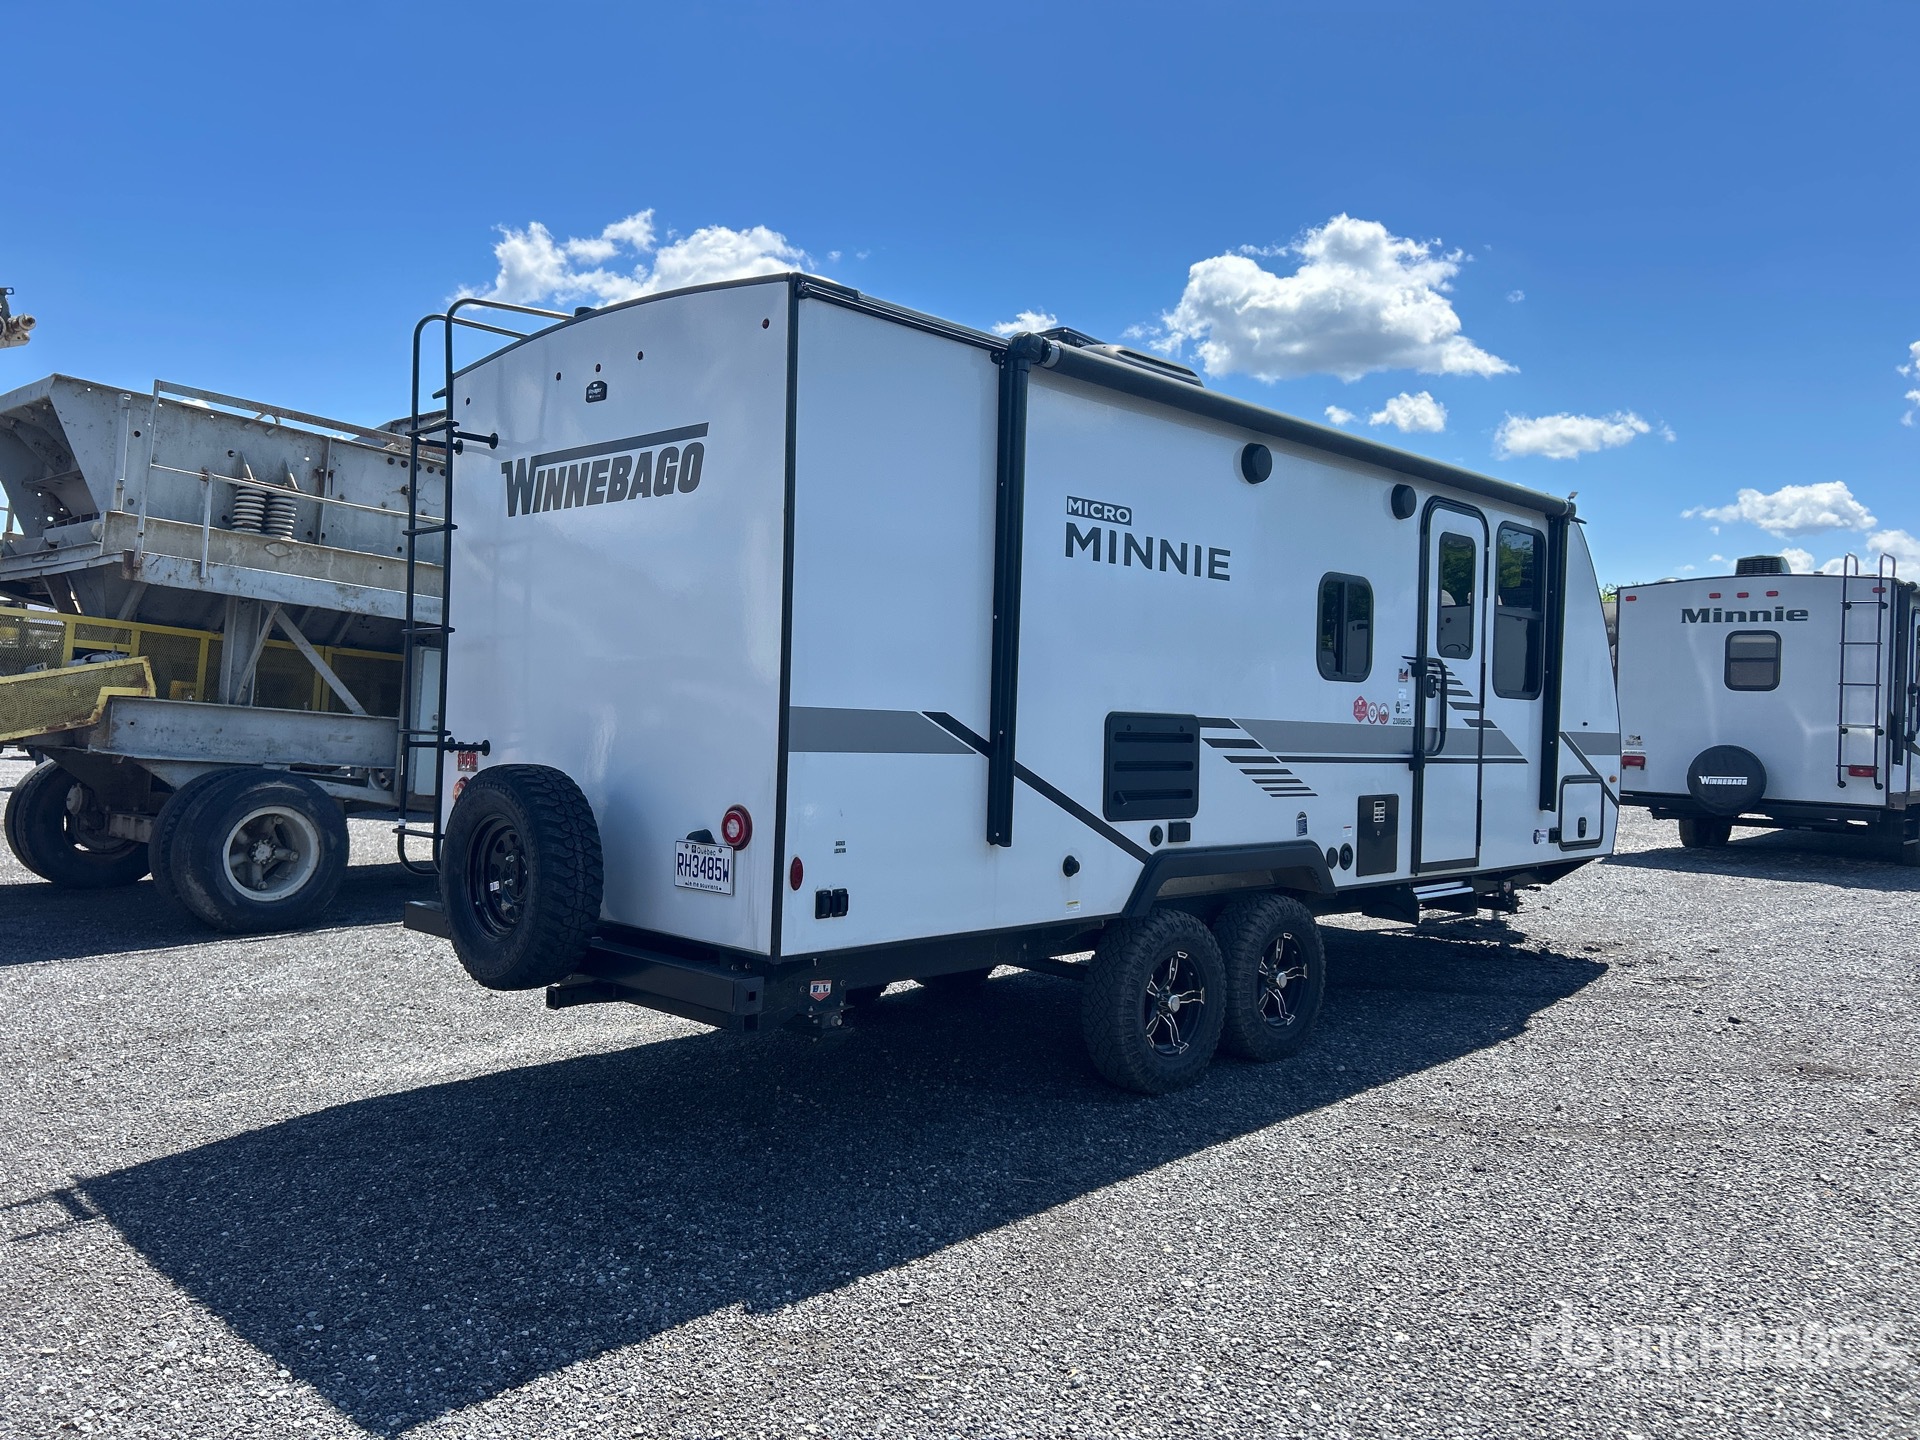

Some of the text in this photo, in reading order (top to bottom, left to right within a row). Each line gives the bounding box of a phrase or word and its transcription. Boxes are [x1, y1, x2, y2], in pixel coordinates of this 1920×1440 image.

[501, 438, 707, 518] WINNEBAGO
[1067, 498, 1130, 523] MICRO
[1065, 522, 1231, 581] MINNIE
[1680, 606, 1809, 624] Minnie
[697, 846, 717, 856] Québec
[677, 852, 730, 883] RH3485W
